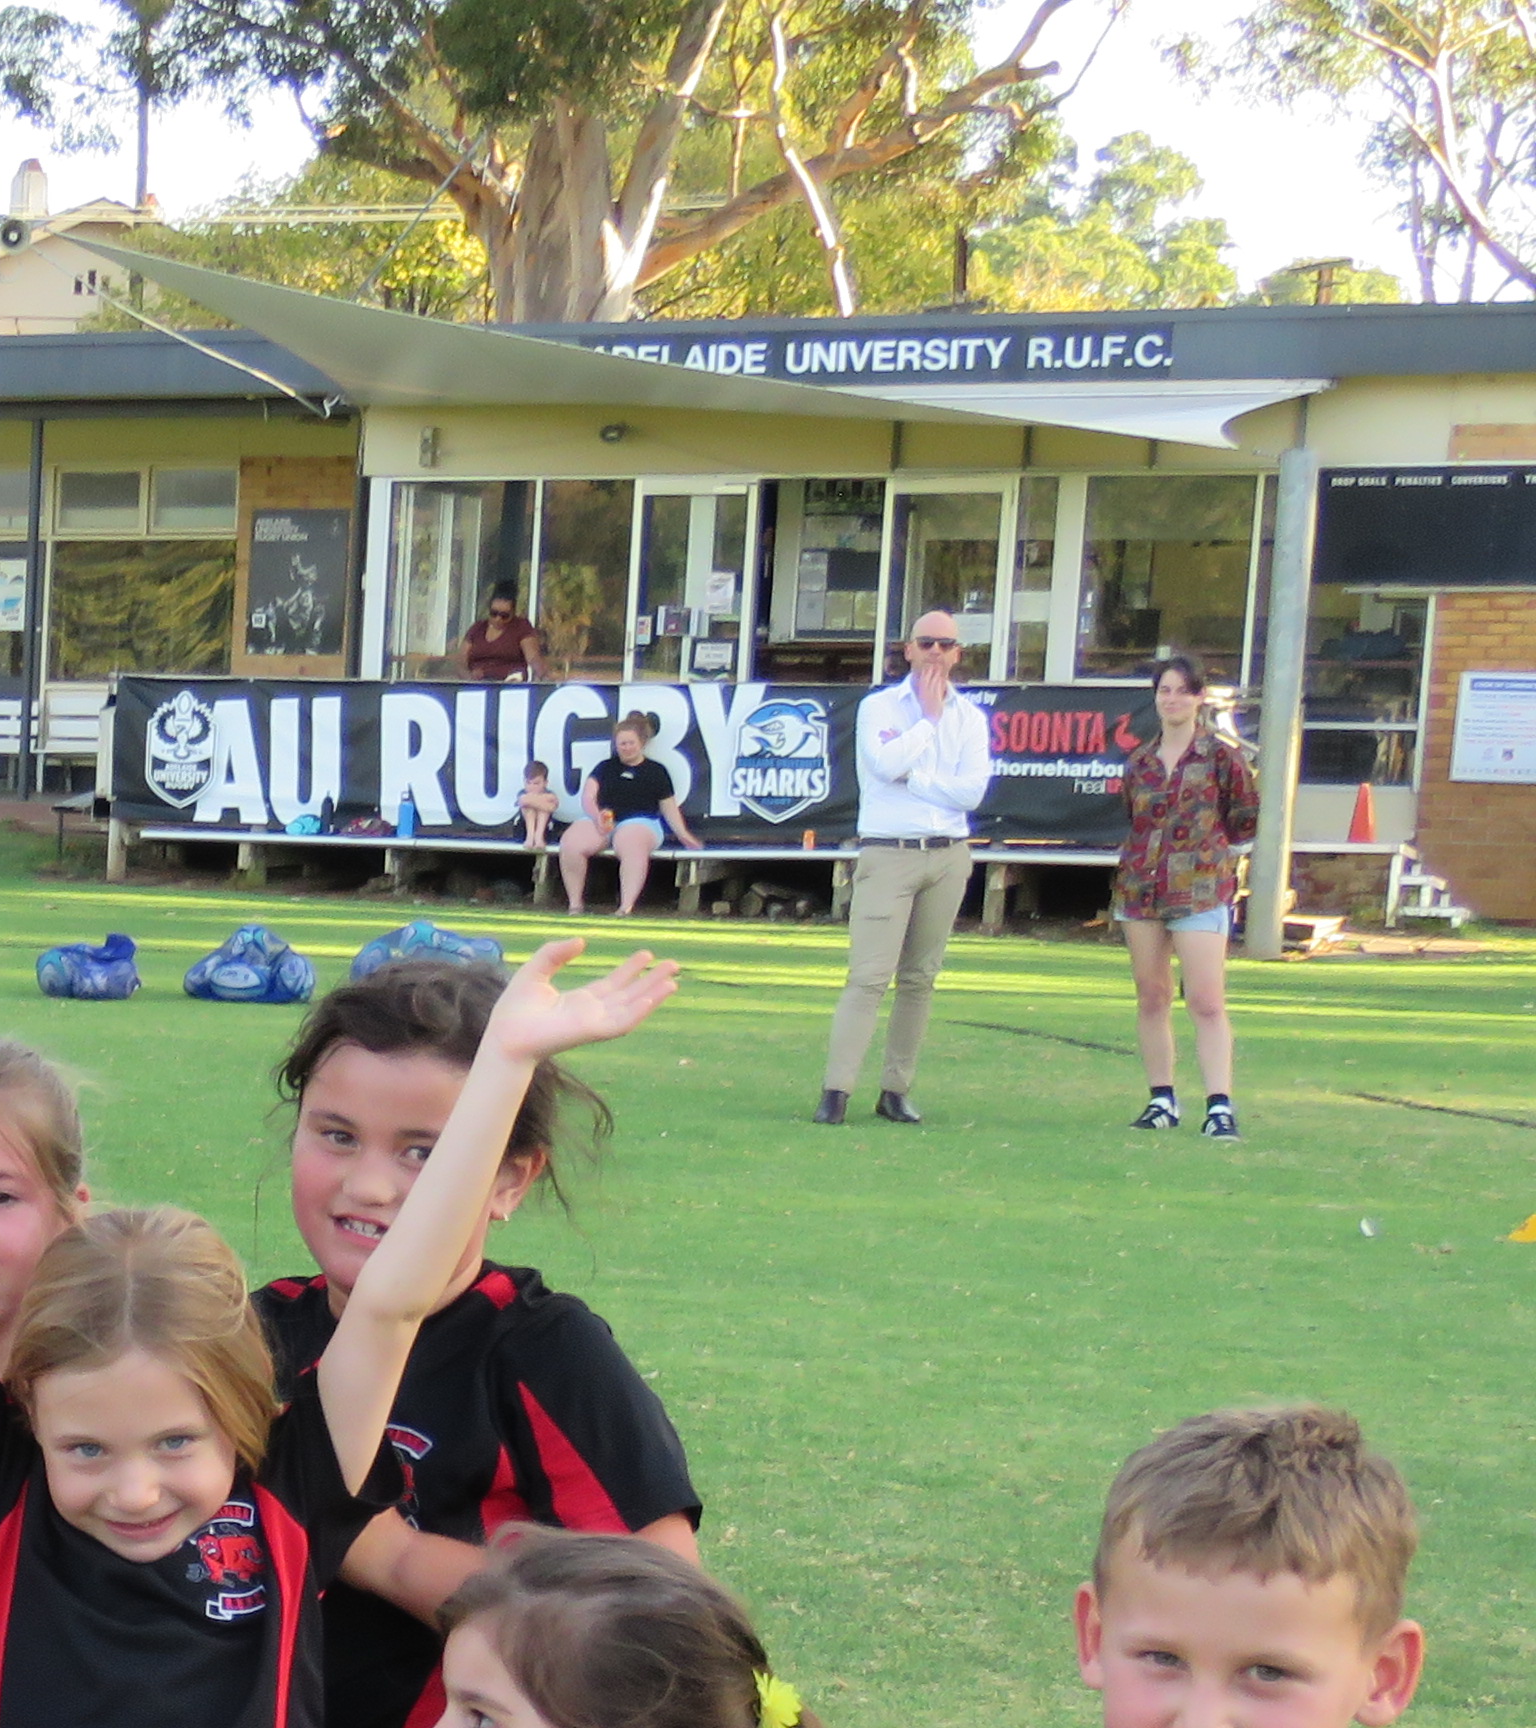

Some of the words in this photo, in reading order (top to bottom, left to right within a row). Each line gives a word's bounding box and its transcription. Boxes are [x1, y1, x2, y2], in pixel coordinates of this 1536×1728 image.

[593, 342, 767, 375] ELAIDE
[785, 337, 1011, 374] UNIVERSITY
[1027, 335, 1174, 369] R.U.F.C.
[991, 710, 1107, 754] SOONTA
[193, 696, 342, 825] AU
[380, 682, 766, 827] RUGBY
[153, 769, 208, 784] UNIVERSITY
[731, 767, 825, 797] SHARKS
